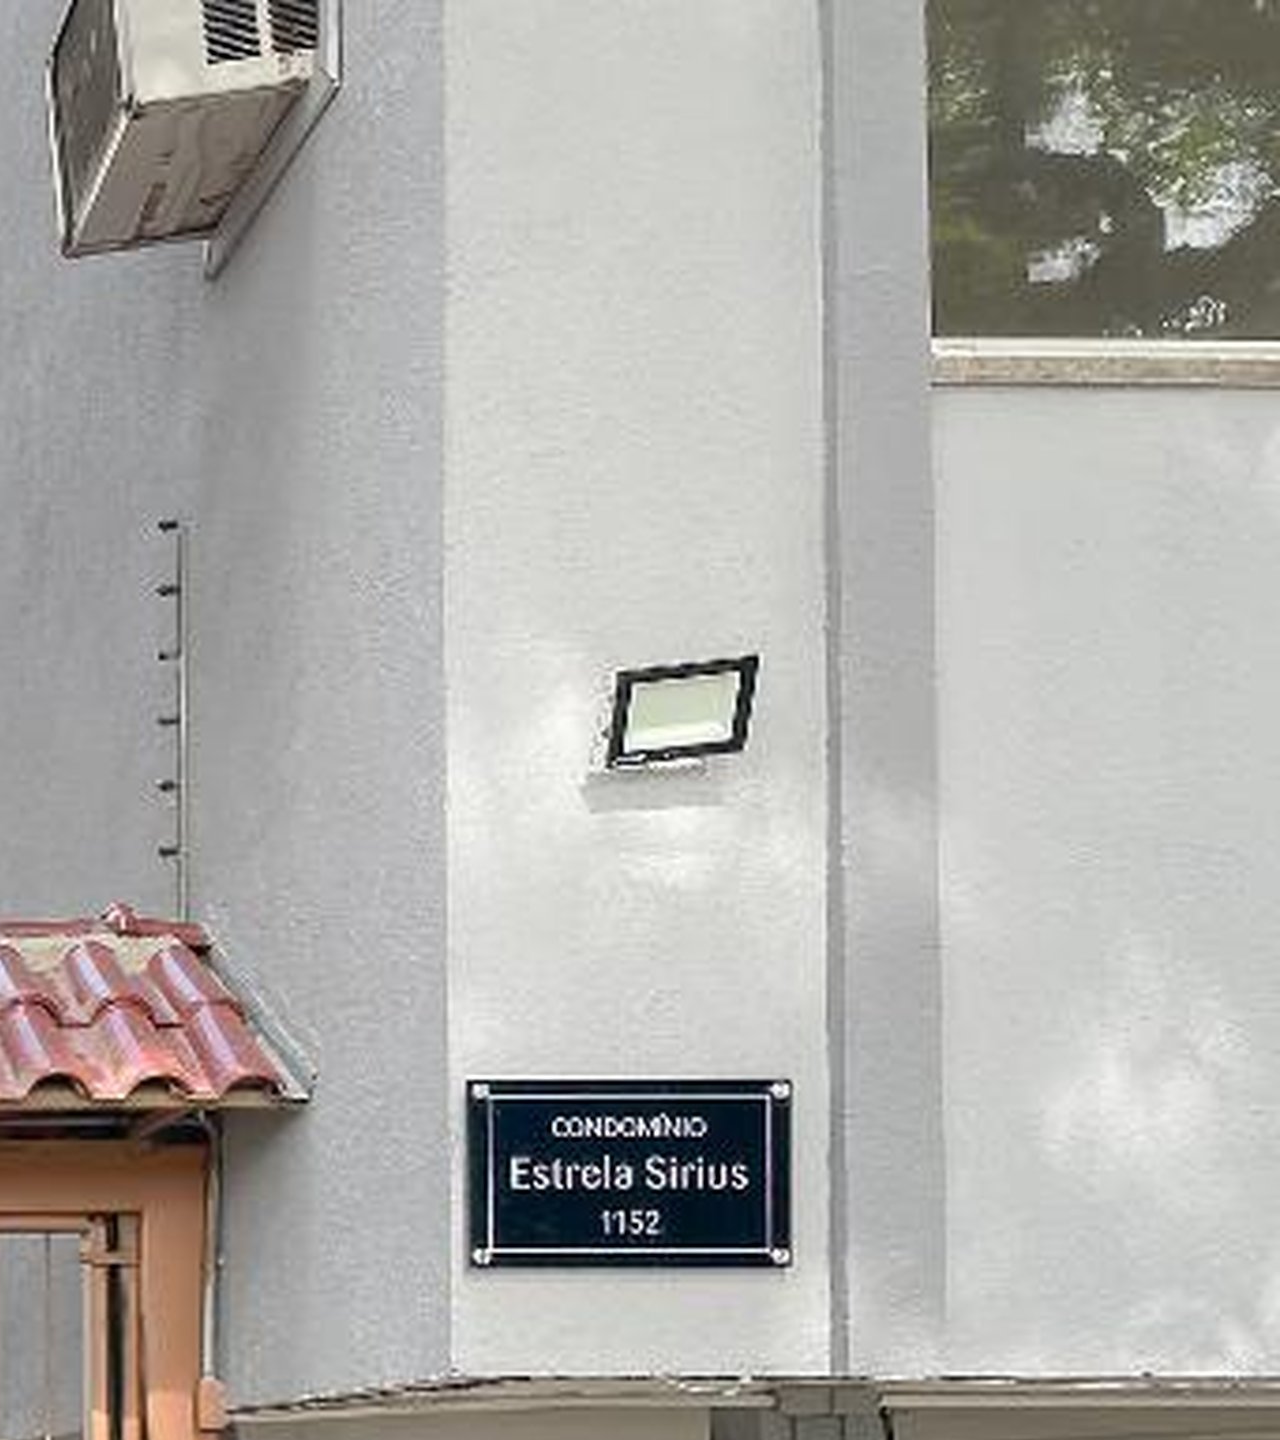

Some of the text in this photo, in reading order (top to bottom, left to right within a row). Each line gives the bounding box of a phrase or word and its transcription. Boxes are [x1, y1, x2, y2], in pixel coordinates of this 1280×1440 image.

[551, 1113, 708, 1138] CONDOMÍNIO
[509, 1155, 750, 1190] Estrela Sirius
[601, 1210, 662, 1234] 1152
